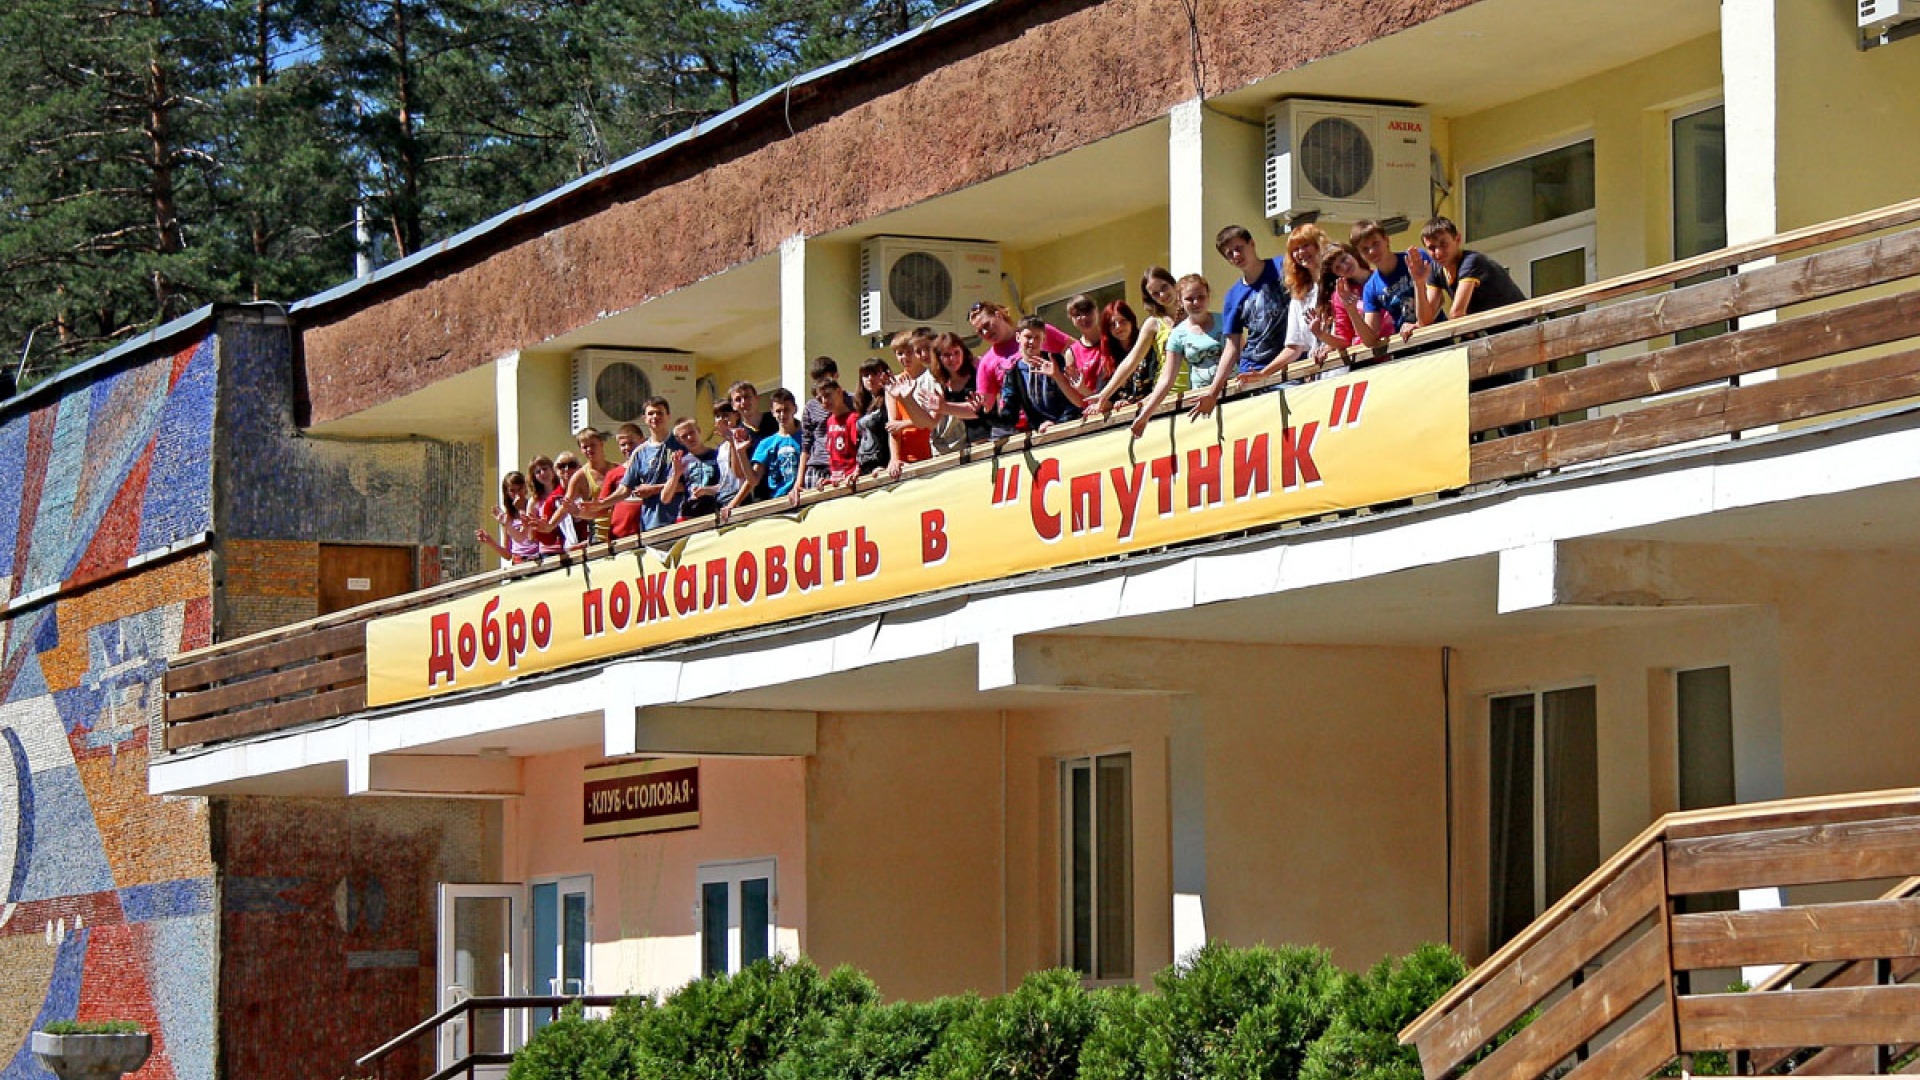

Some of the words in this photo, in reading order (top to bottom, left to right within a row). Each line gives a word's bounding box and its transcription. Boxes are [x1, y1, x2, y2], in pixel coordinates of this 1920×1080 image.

[1387, 121, 1422, 132] AKIRA
[429, 596, 551, 687] Добро
[583, 526, 880, 636] пожаловать
[921, 509, 949, 565] в
